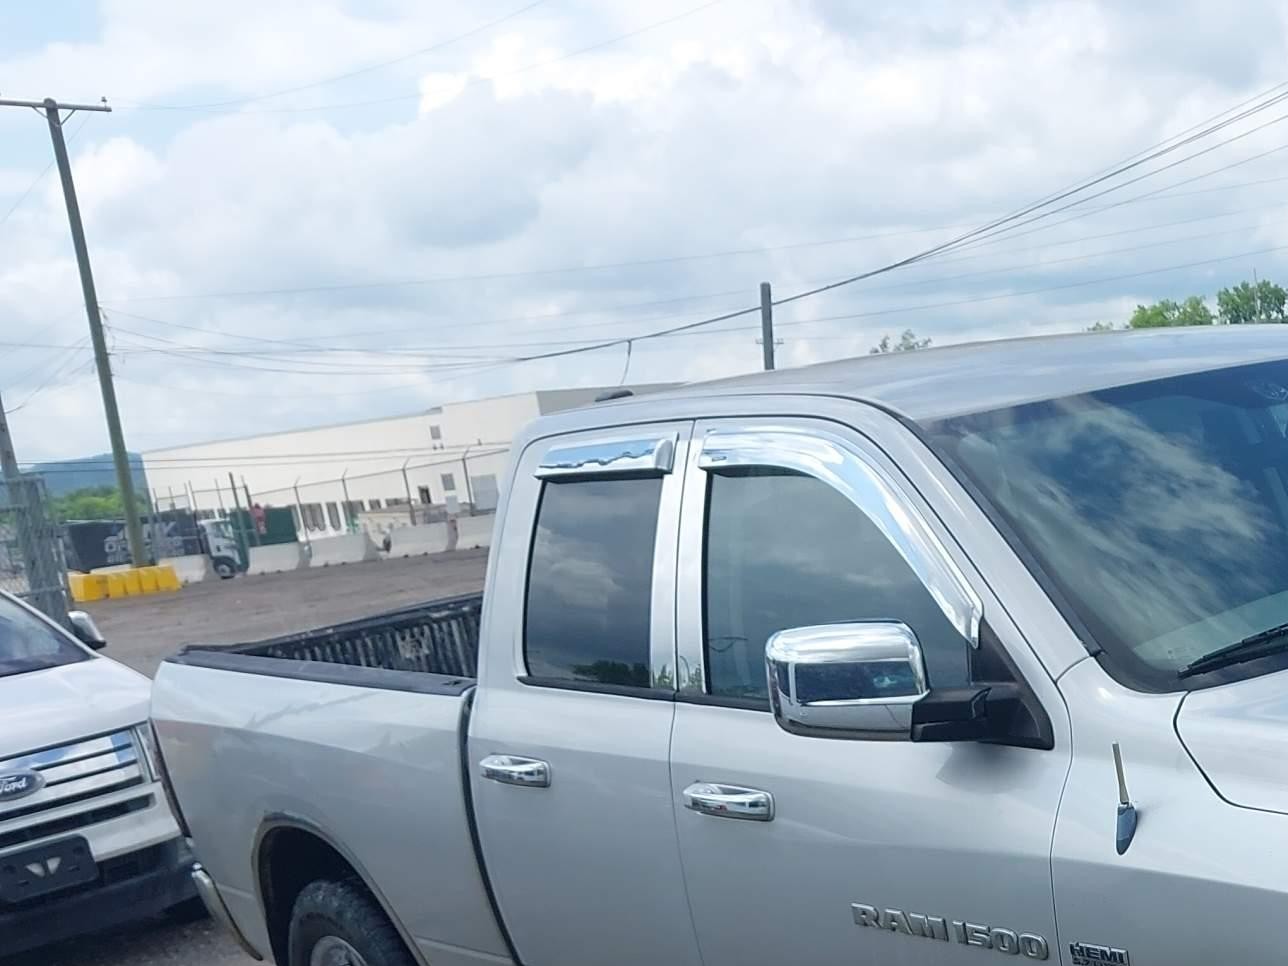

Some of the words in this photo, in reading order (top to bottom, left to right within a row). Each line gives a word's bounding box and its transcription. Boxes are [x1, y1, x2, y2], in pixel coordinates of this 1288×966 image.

[850, 902, 949, 942] RAM
[952, 919, 1050, 961] 1500
[1069, 942, 1125, 963] HEMI
